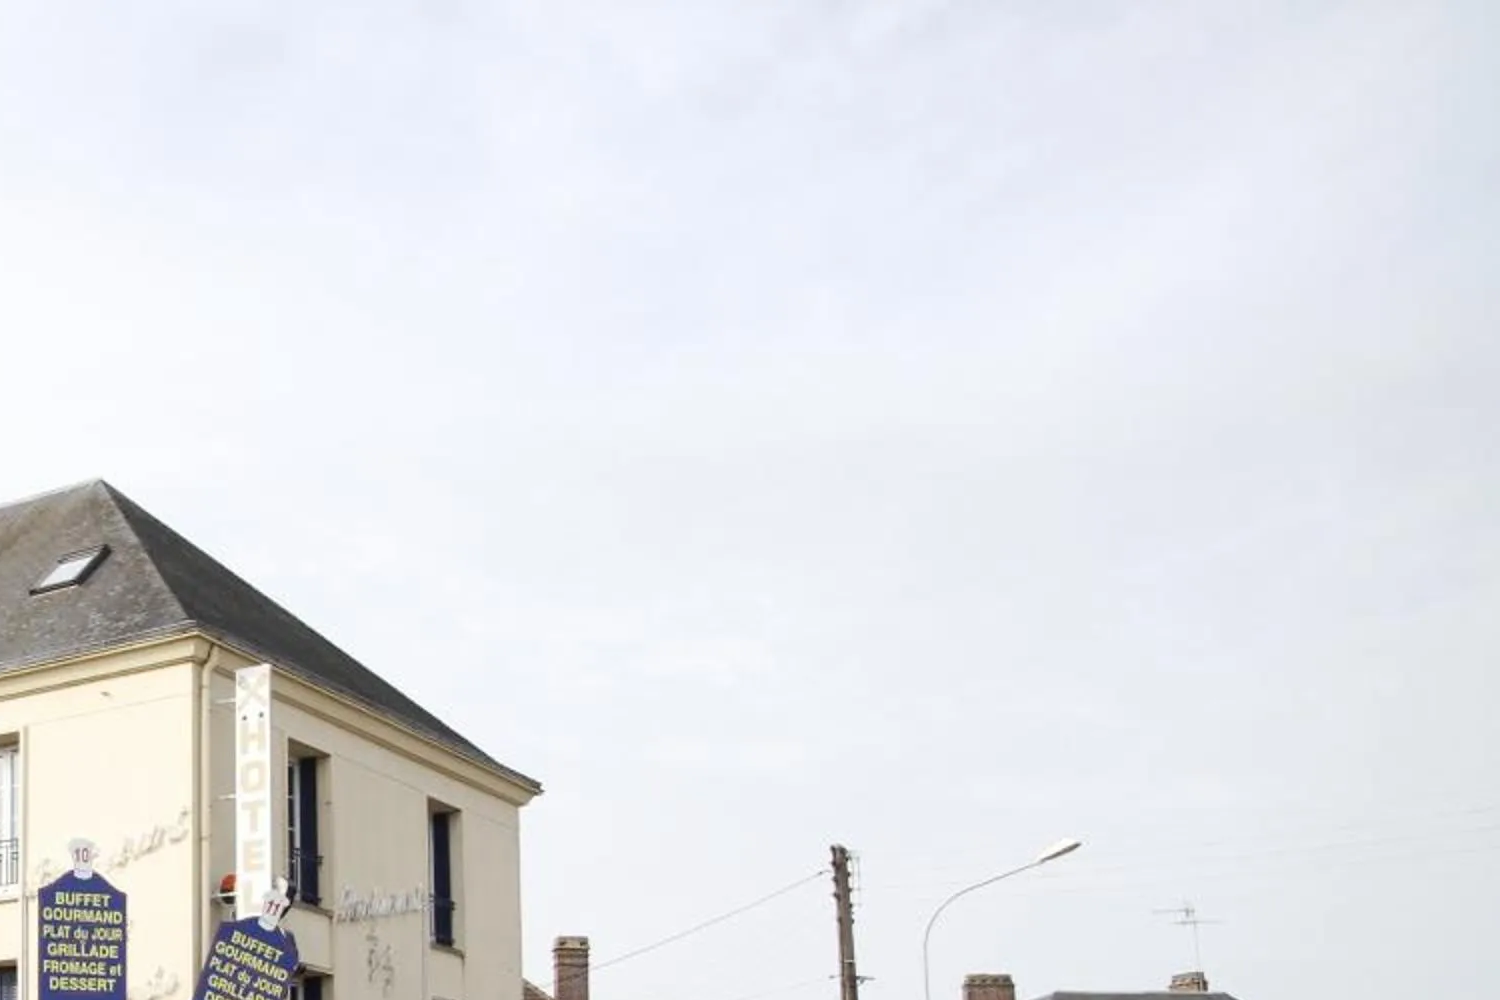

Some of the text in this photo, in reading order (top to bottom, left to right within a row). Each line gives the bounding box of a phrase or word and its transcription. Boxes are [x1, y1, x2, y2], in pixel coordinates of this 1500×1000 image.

[54, 892, 112, 908] BUFFET
[43, 907, 123, 925] GOURMAND
[43, 924, 123, 942] PLAT du JOUR
[47, 942, 119, 959] GRILLADE
[231, 930, 284, 963] BUFFET
[43, 959, 107, 976] FROMAGE
[215, 941, 289, 982] GOURMAND
[49, 976, 117, 993] DESSERT
[209, 955, 283, 998] PLAT du JOUR
